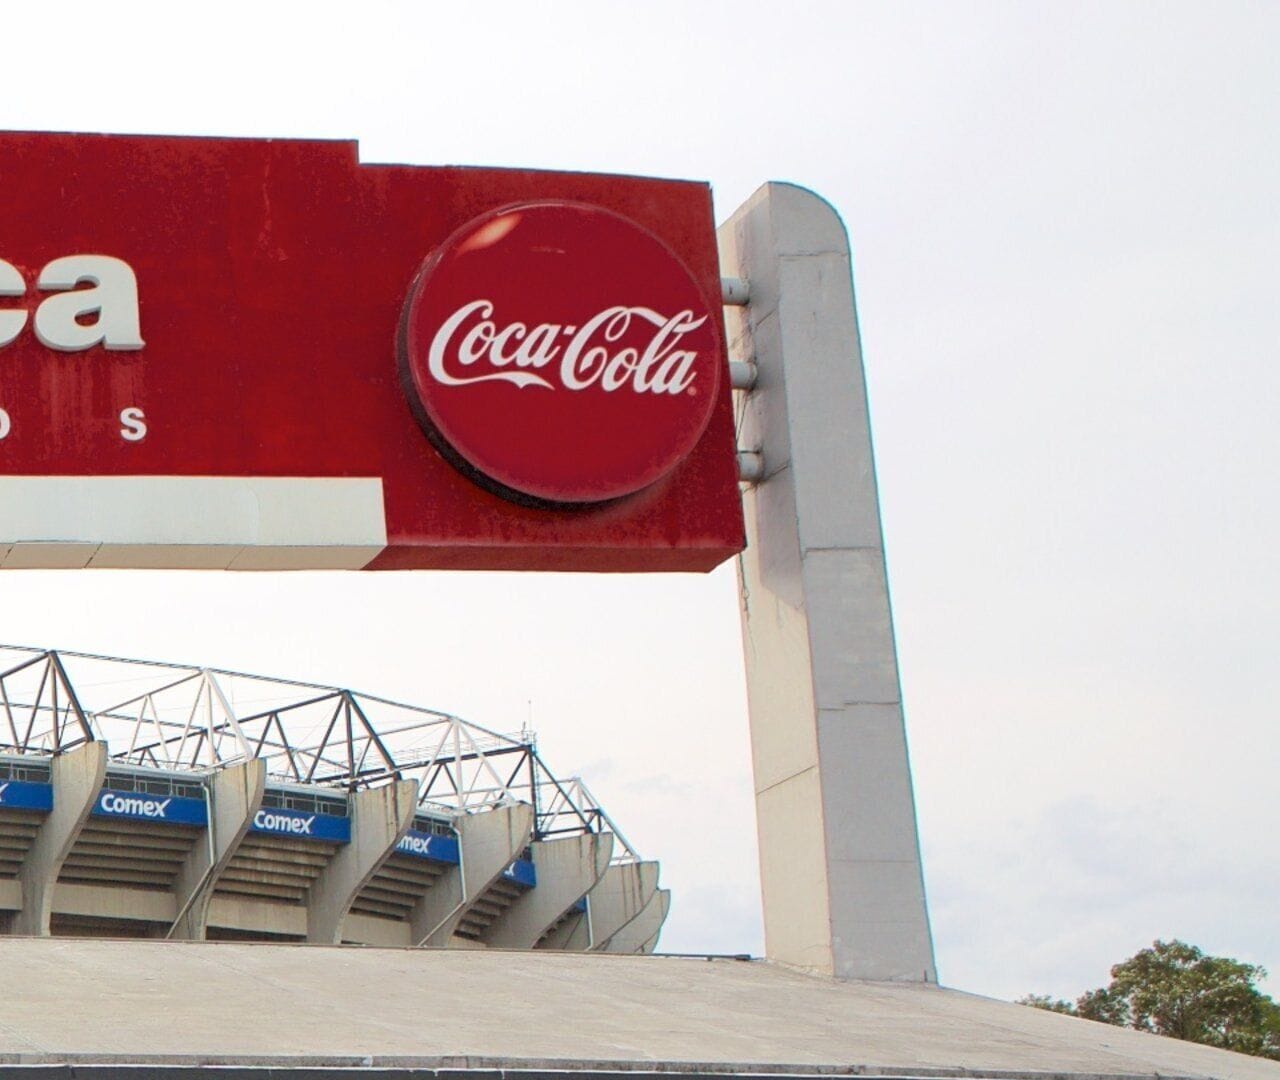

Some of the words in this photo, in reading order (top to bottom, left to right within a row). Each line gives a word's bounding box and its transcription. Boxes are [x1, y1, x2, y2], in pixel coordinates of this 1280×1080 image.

[429, 300, 708, 394] Coca-Cola
[101, 792, 173, 817] Comex
[253, 810, 315, 834] Comex
